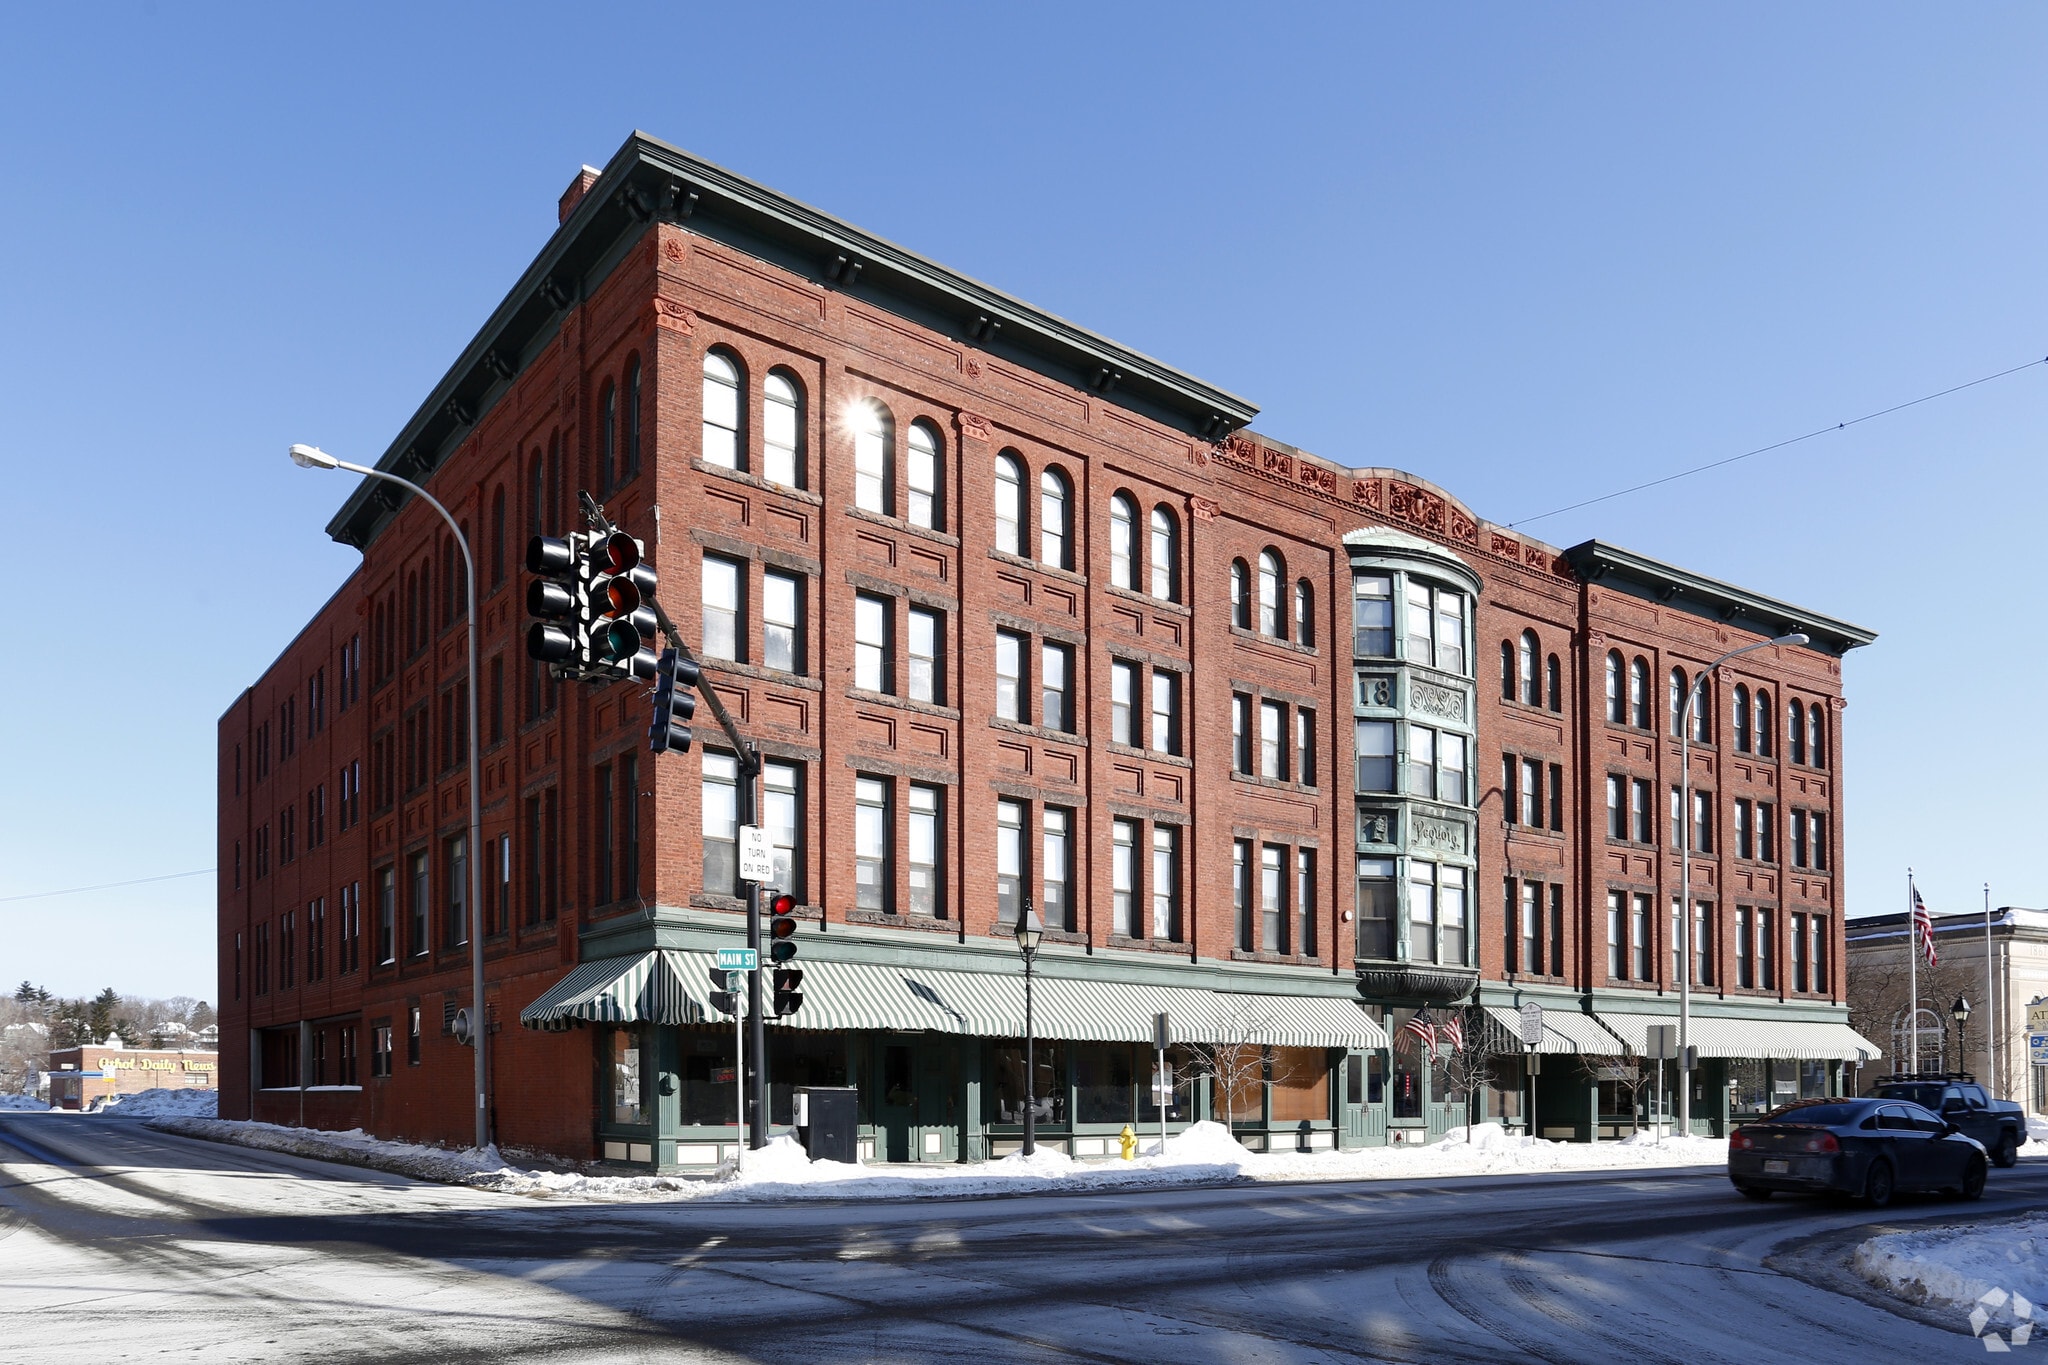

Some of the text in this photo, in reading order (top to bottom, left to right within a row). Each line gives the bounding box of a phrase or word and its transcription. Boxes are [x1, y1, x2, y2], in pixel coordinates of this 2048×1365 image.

[1360, 679, 1390, 704] 18
[752, 832, 762, 843] NO
[748, 848, 766, 858] TURN
[743, 862, 770, 875] ON RED
[720, 953, 755, 966] MAIN ST
[98, 1057, 216, 1073] Athol Daily News
